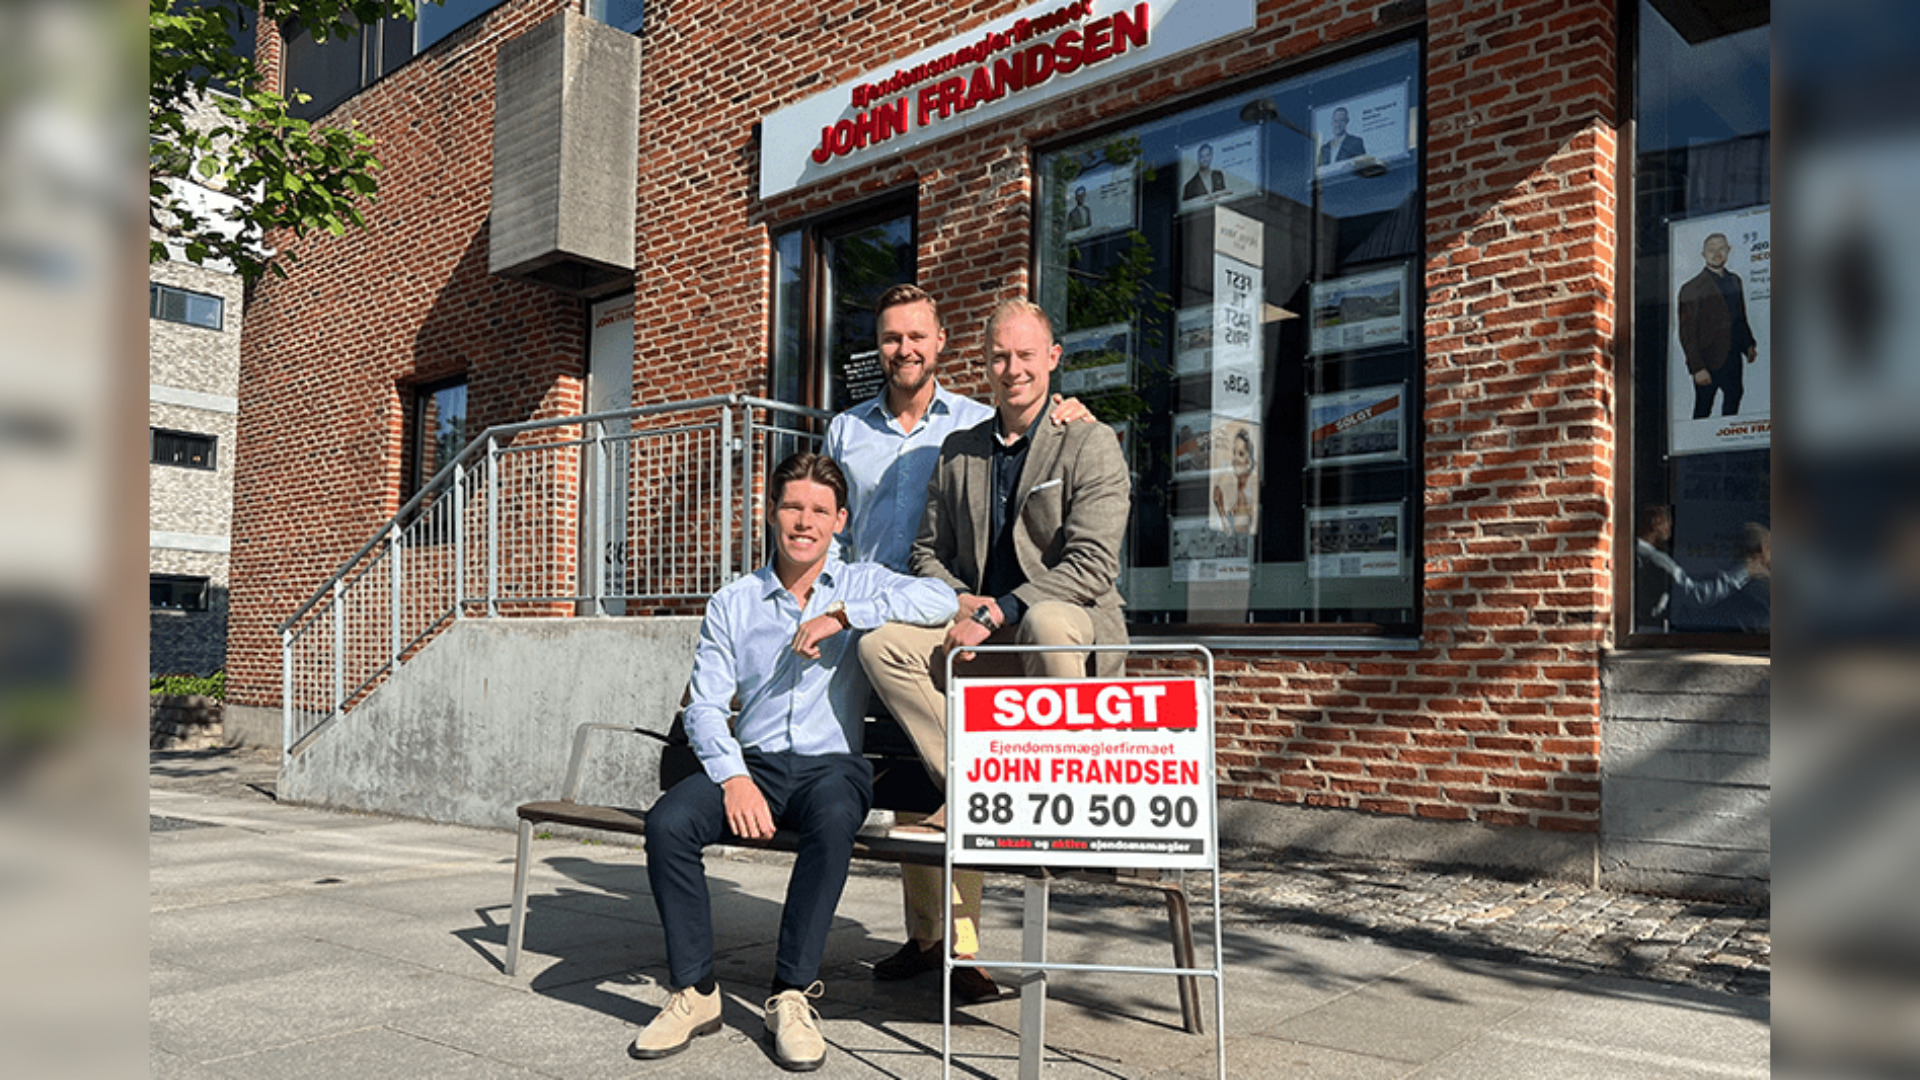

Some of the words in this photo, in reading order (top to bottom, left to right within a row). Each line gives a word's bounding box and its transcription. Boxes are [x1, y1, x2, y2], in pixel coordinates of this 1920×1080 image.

[812, 97, 908, 163] JOHN
[917, 2, 1149, 126] FRANDSEN
[1335, 407, 1373, 431] SOLGT
[1716, 426, 1748, 436] JOHN
[992, 684, 1167, 727] SOLGT
[989, 741, 1174, 756] Ejendomsmæglerfirmaet
[966, 757, 1041, 783] JOHN
[1051, 758, 1199, 785] FRANDSEN
[968, 792, 1013, 824] 88
[1028, 793, 1074, 826] 70
[1088, 794, 1135, 827] 50
[1149, 796, 1198, 828] 90
[975, 837, 995, 848] Din
[997, 838, 1032, 848] lokale
[1034, 839, 1049, 851] og
